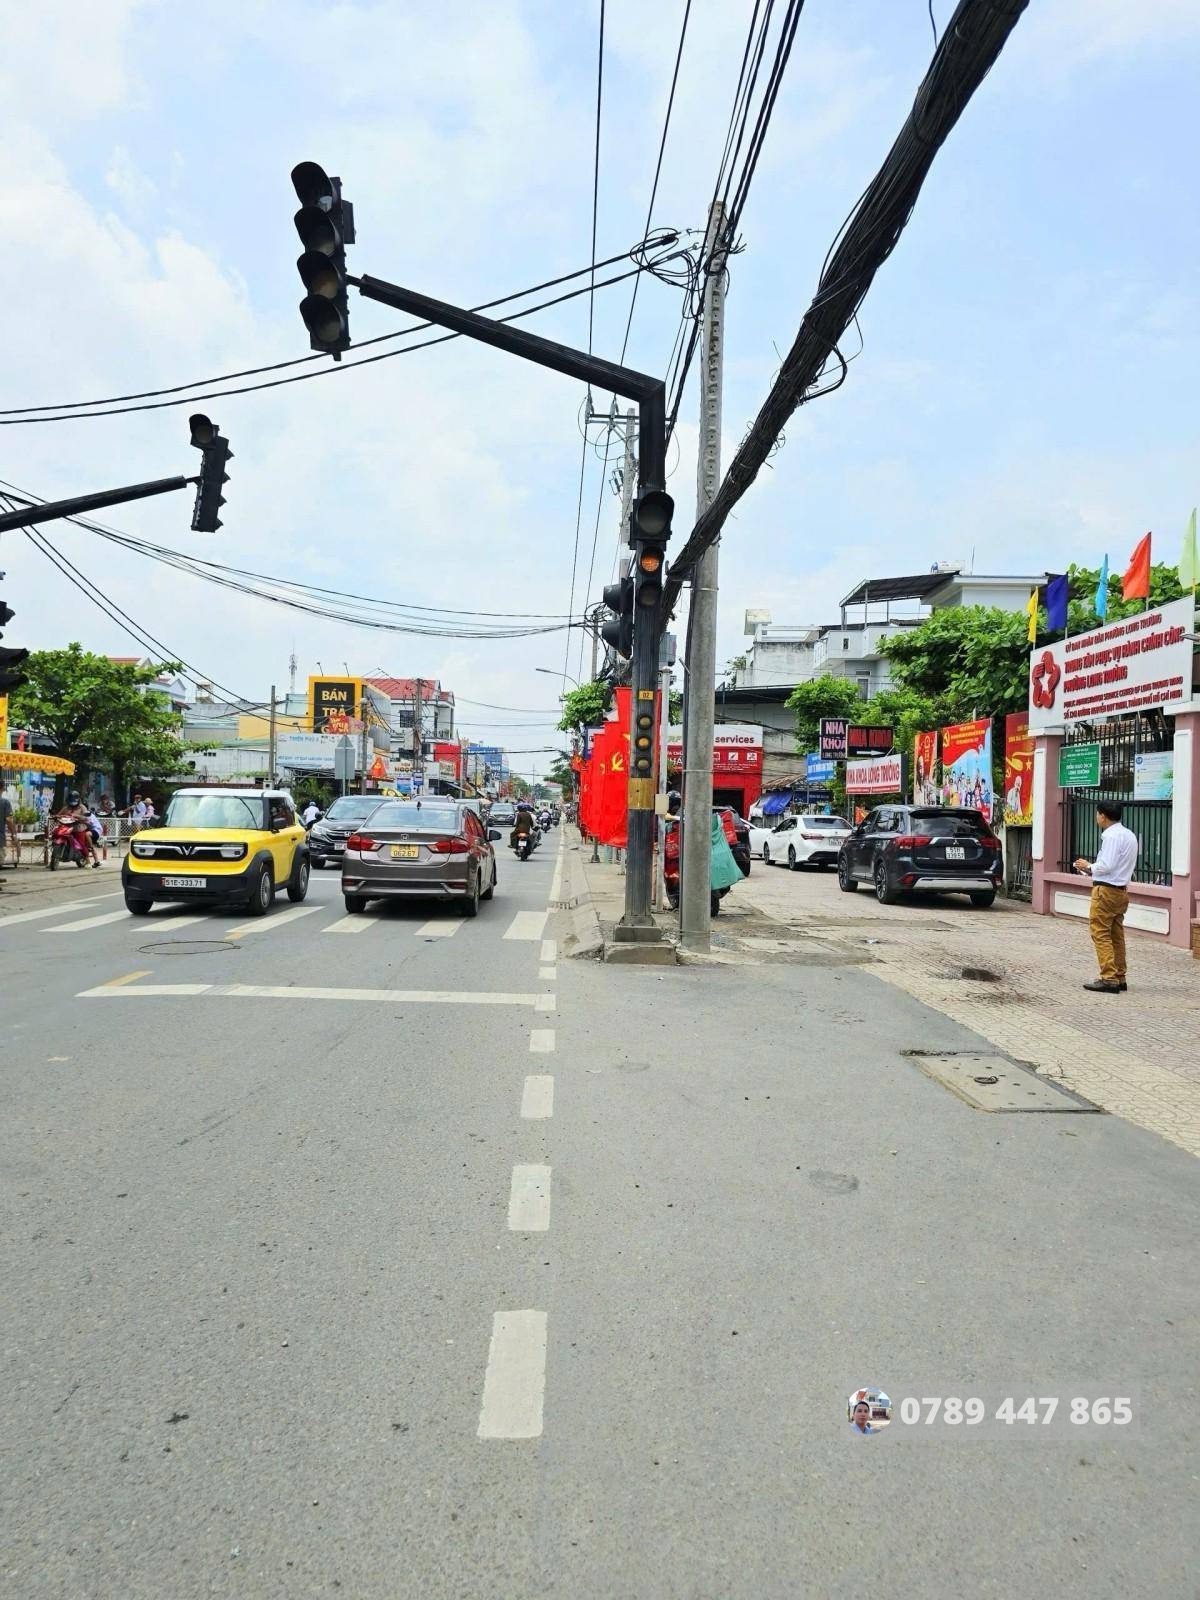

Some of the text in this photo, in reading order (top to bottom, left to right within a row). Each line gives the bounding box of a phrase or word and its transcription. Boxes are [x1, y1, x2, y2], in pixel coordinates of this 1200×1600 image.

[321, 688, 347, 701] BÁN
[825, 721, 845, 735] NHA
[714, 734, 755, 744] services
